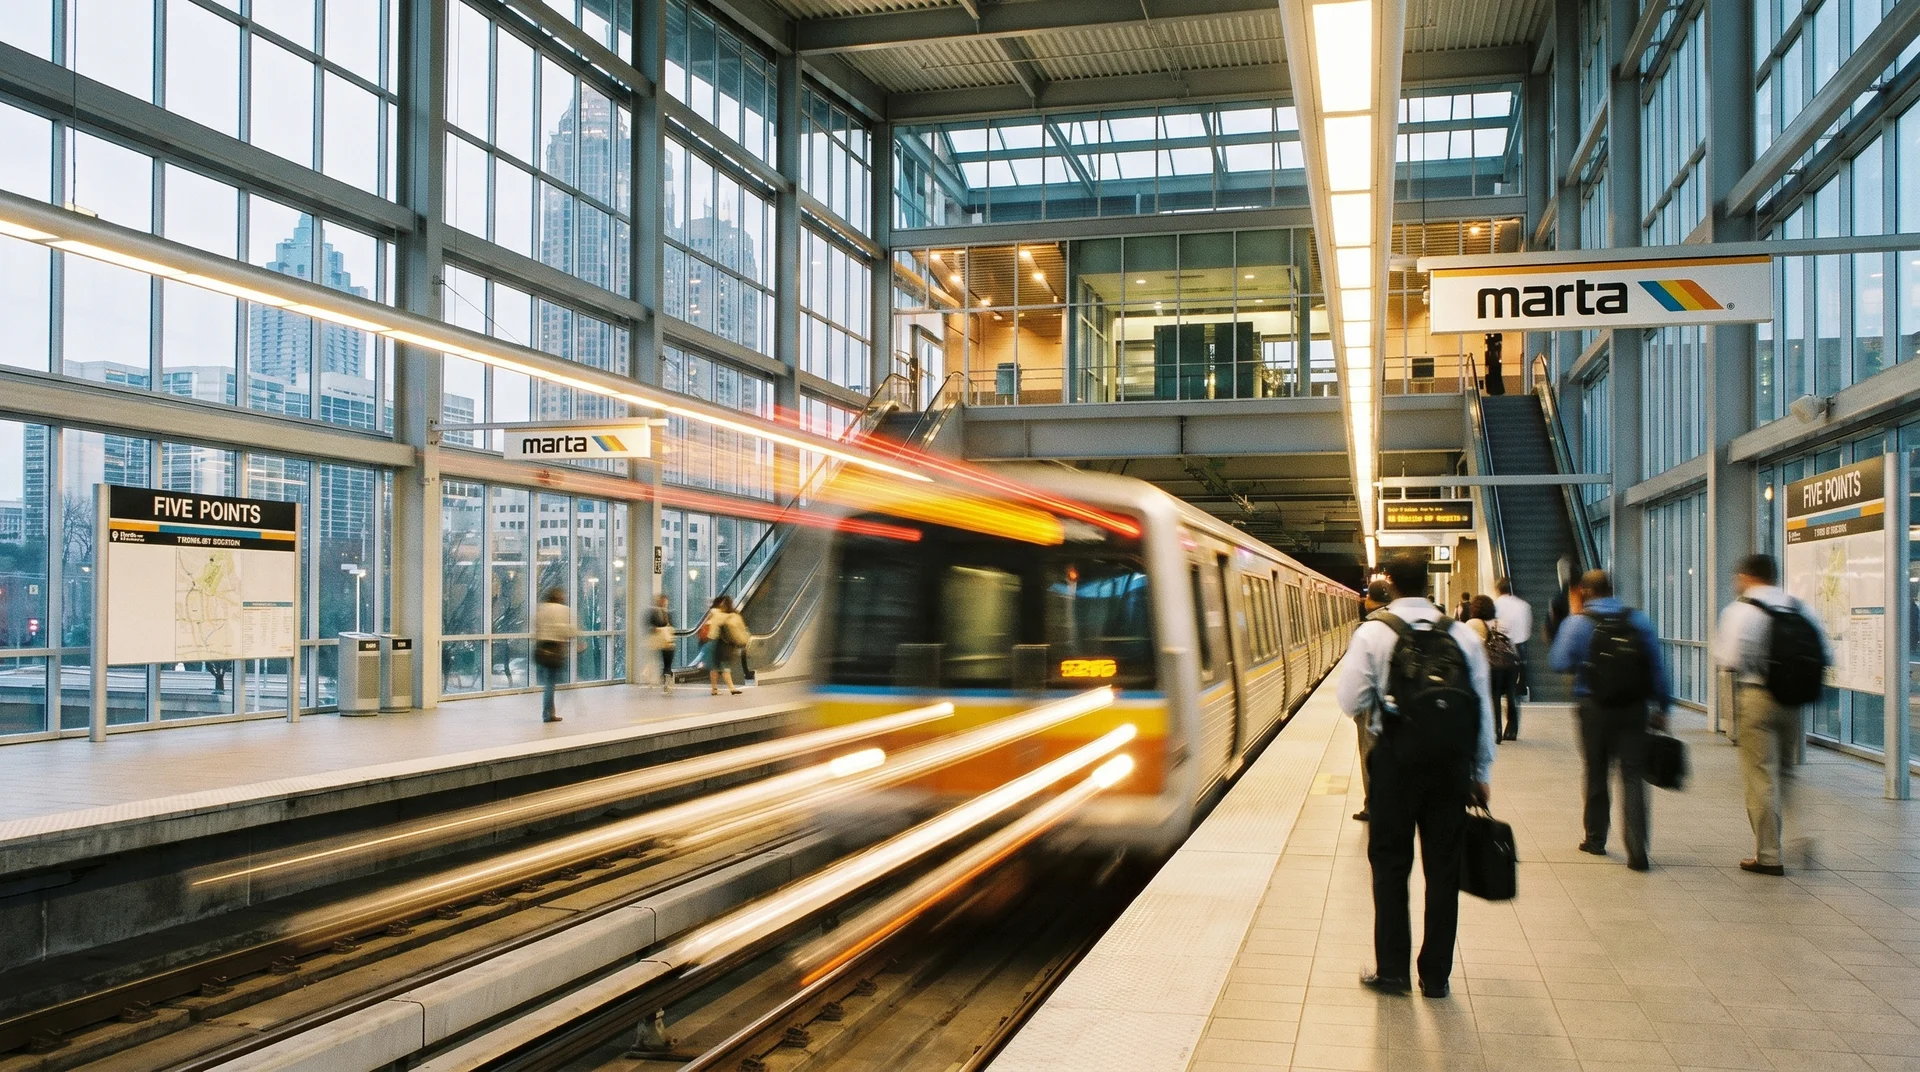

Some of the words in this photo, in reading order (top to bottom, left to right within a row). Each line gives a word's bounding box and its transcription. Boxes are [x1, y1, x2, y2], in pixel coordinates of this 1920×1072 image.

[1477, 279, 1628, 319] marta
[522, 435, 587, 454] marta
[1803, 481, 1823, 509] FIVE
[1825, 470, 1861, 503] POINTS
[154, 496, 193, 518] FIVE
[200, 500, 261, 523] POINTS
